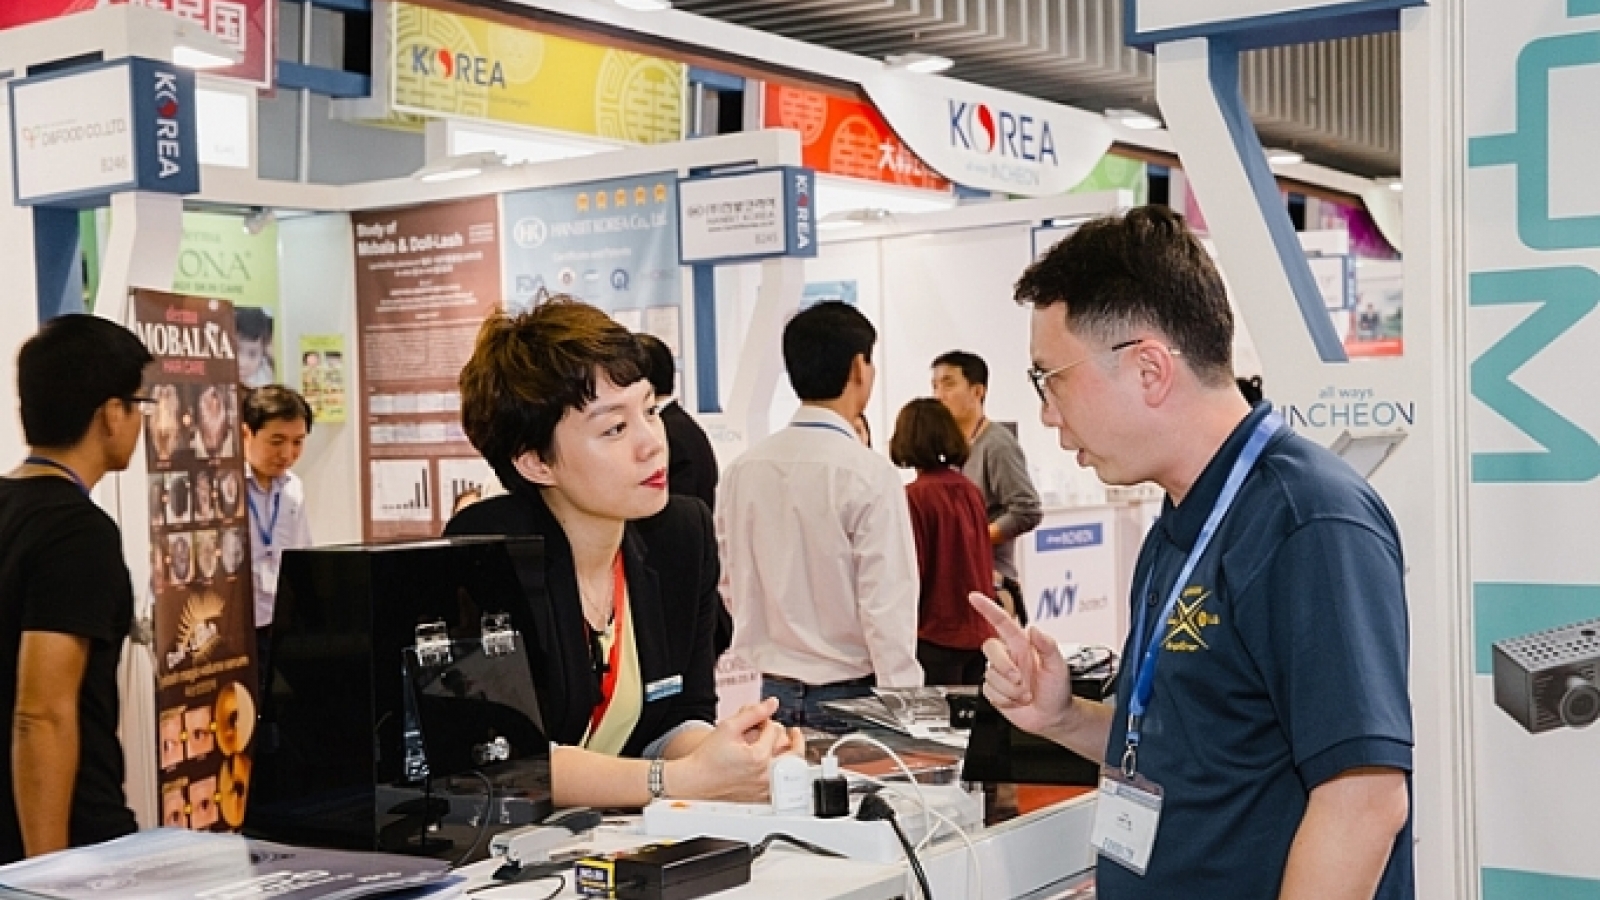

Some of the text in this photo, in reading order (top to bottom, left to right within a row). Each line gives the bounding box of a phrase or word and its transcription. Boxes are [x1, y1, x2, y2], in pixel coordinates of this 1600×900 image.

[411, 44, 507, 89] KOREA
[153, 71, 182, 179] KOREA
[947, 98, 1058, 167] KOREA
[1318, 385, 1374, 402] all ways
